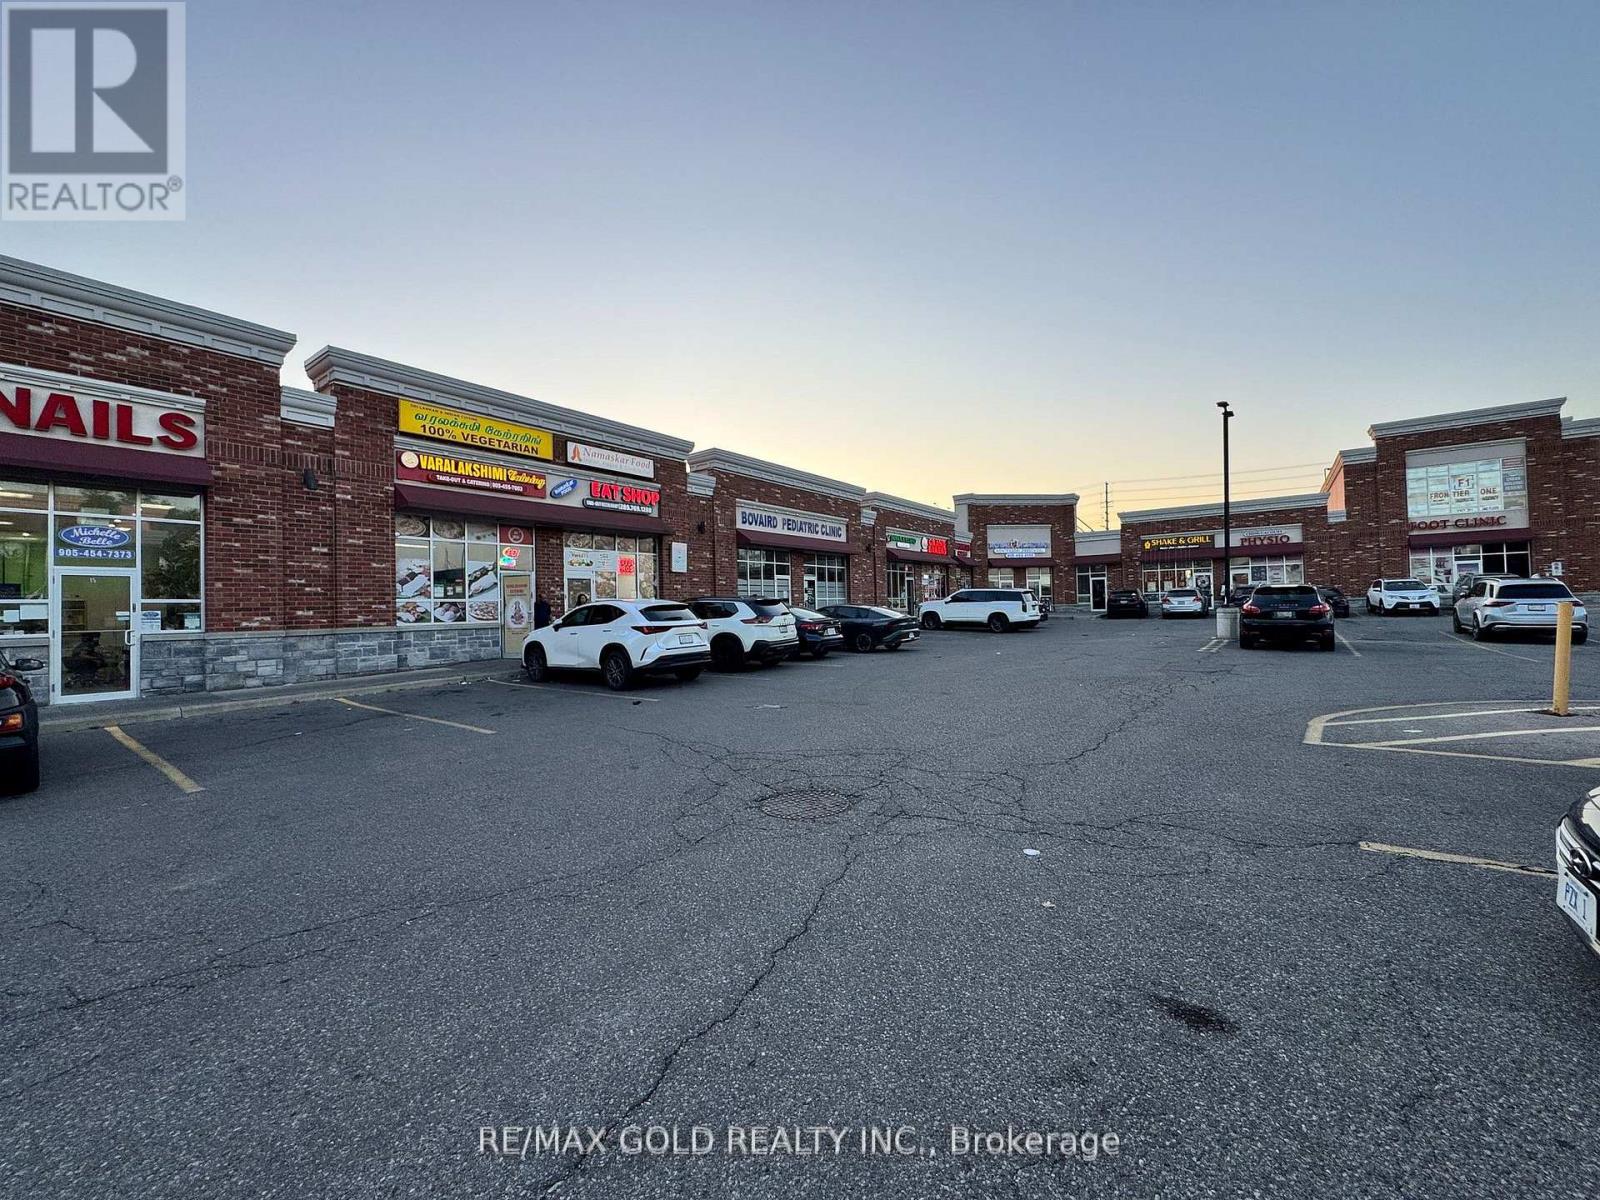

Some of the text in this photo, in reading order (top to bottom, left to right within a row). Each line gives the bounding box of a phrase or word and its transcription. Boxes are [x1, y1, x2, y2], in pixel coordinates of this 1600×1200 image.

[0, 386, 197, 450] NAILS
[420, 424, 539, 455] 100% VEGETARIAN
[583, 447, 630, 465] Namaskar
[630, 459, 651, 470] Food
[419, 454, 507, 481] VARALAKSHIMI
[1458, 478, 1470, 487] F1
[591, 480, 619, 499] EAT
[622, 485, 660, 506] SHOP
[1480, 487, 1497, 495] ONE
[741, 511, 842, 538] BOVAIRD PEDIATRIC CLINIC
[1408, 515, 1507, 530] FOOT CLINIC
[70, 528, 121, 541] Michelle
[79, 537, 113, 546] Belle
[1151, 535, 1211, 546] SHAKE & GRILL
[1240, 534, 1290, 546] PHYSIO
[58, 548, 132, 559] 905-454-7373
